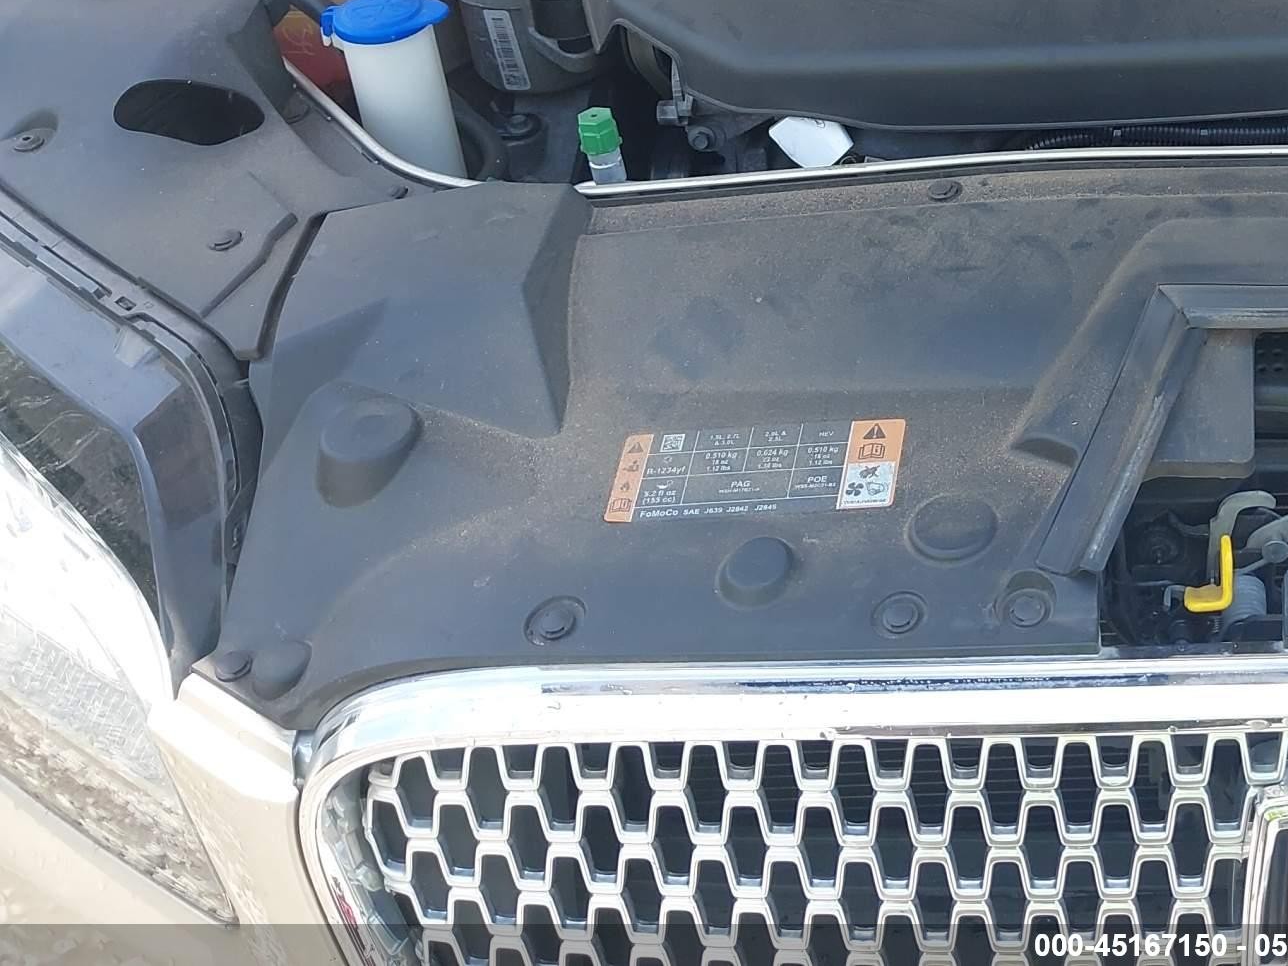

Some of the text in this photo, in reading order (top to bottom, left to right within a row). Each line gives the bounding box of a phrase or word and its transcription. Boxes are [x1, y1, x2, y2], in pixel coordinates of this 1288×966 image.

[778, 448, 788, 456] kg
[646, 466, 686, 476] R-1234yf
[807, 474, 828, 483] POE
[730, 479, 751, 488] PAG
[639, 508, 679, 518] FoMoCo
[682, 507, 700, 515] SAE
[703, 506, 723, 514] J639
